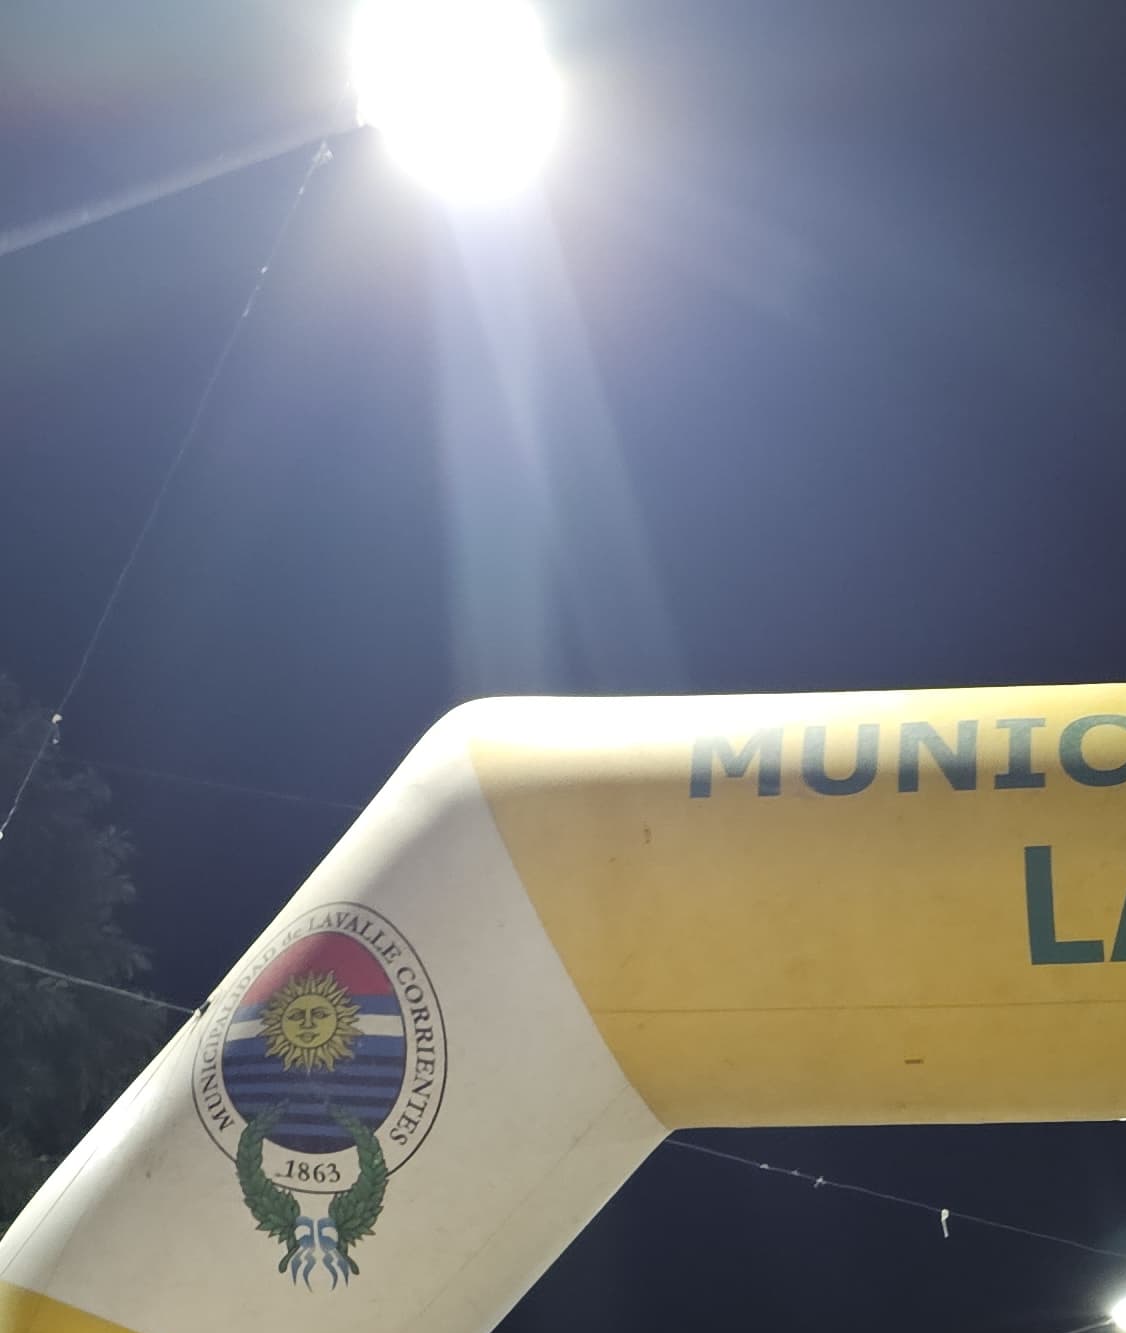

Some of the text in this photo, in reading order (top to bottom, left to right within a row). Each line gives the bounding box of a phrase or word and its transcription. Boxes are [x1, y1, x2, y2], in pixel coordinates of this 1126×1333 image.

[308, 911, 402, 965] LAVALLE
[389, 966, 436, 1146] CORRIENTES
[286, 1160, 341, 1183] 1863
